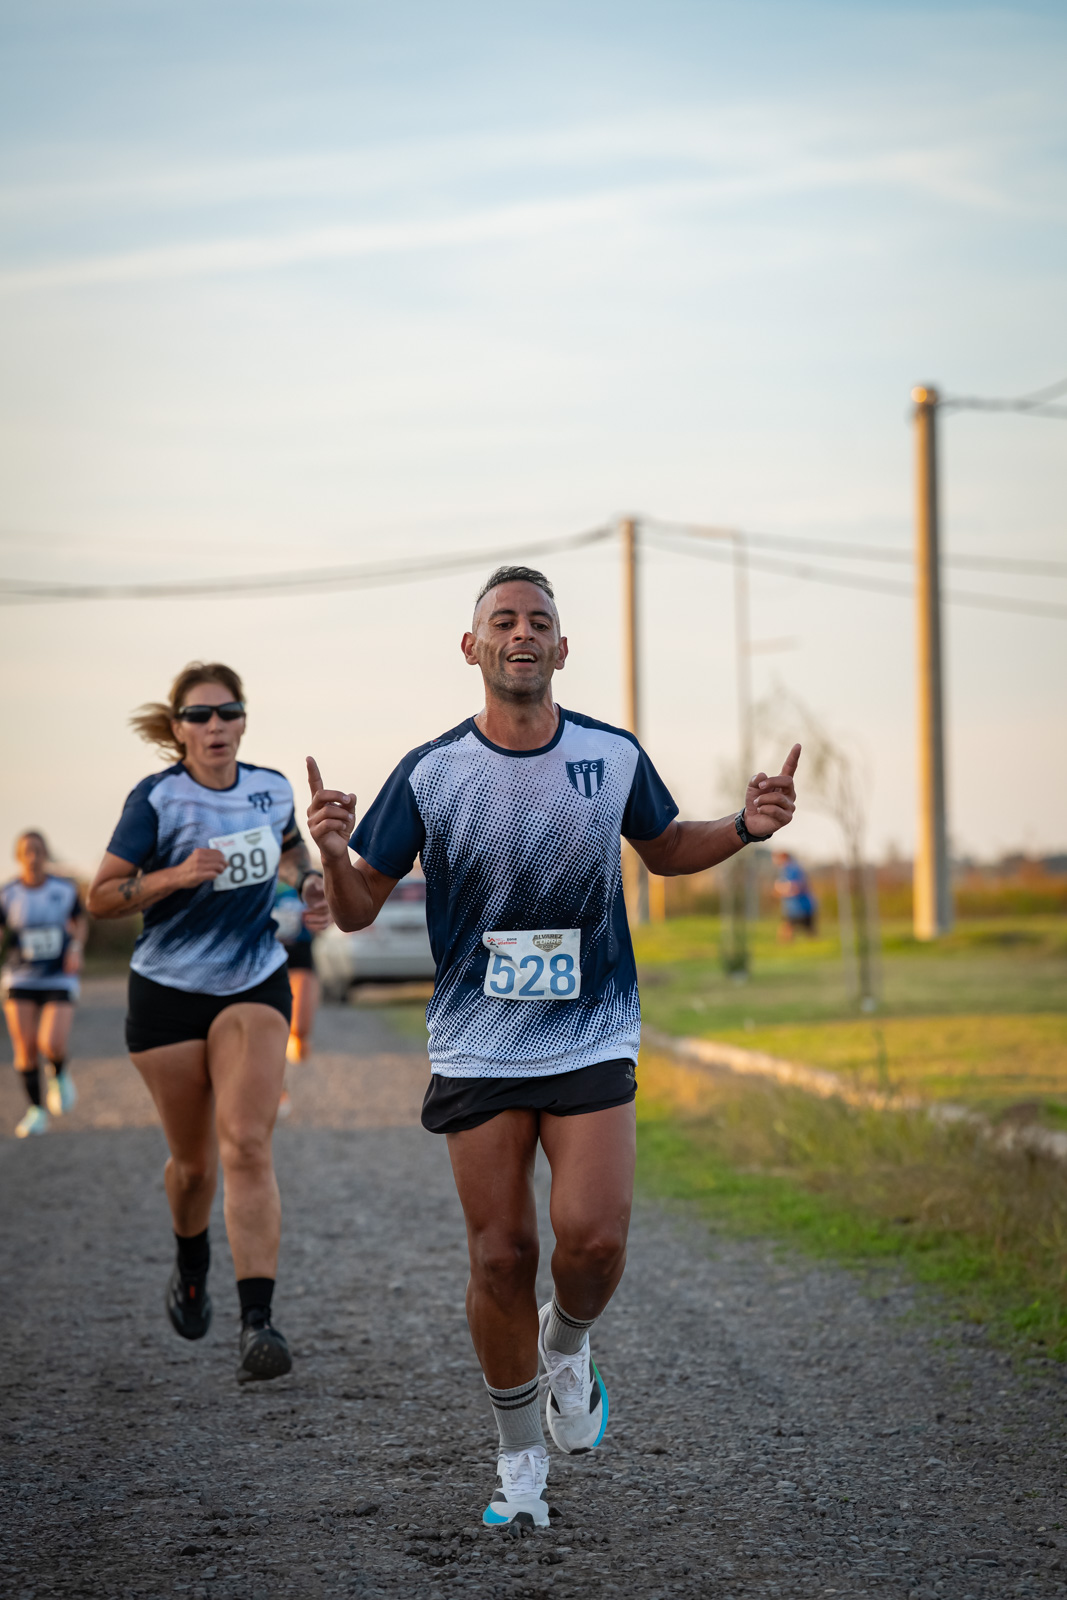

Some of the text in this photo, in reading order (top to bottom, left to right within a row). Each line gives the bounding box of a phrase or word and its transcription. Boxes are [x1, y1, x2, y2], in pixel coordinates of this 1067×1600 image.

[573, 762, 598, 773] SFC
[229, 848, 268, 884] 89
[489, 953, 576, 996] 528
